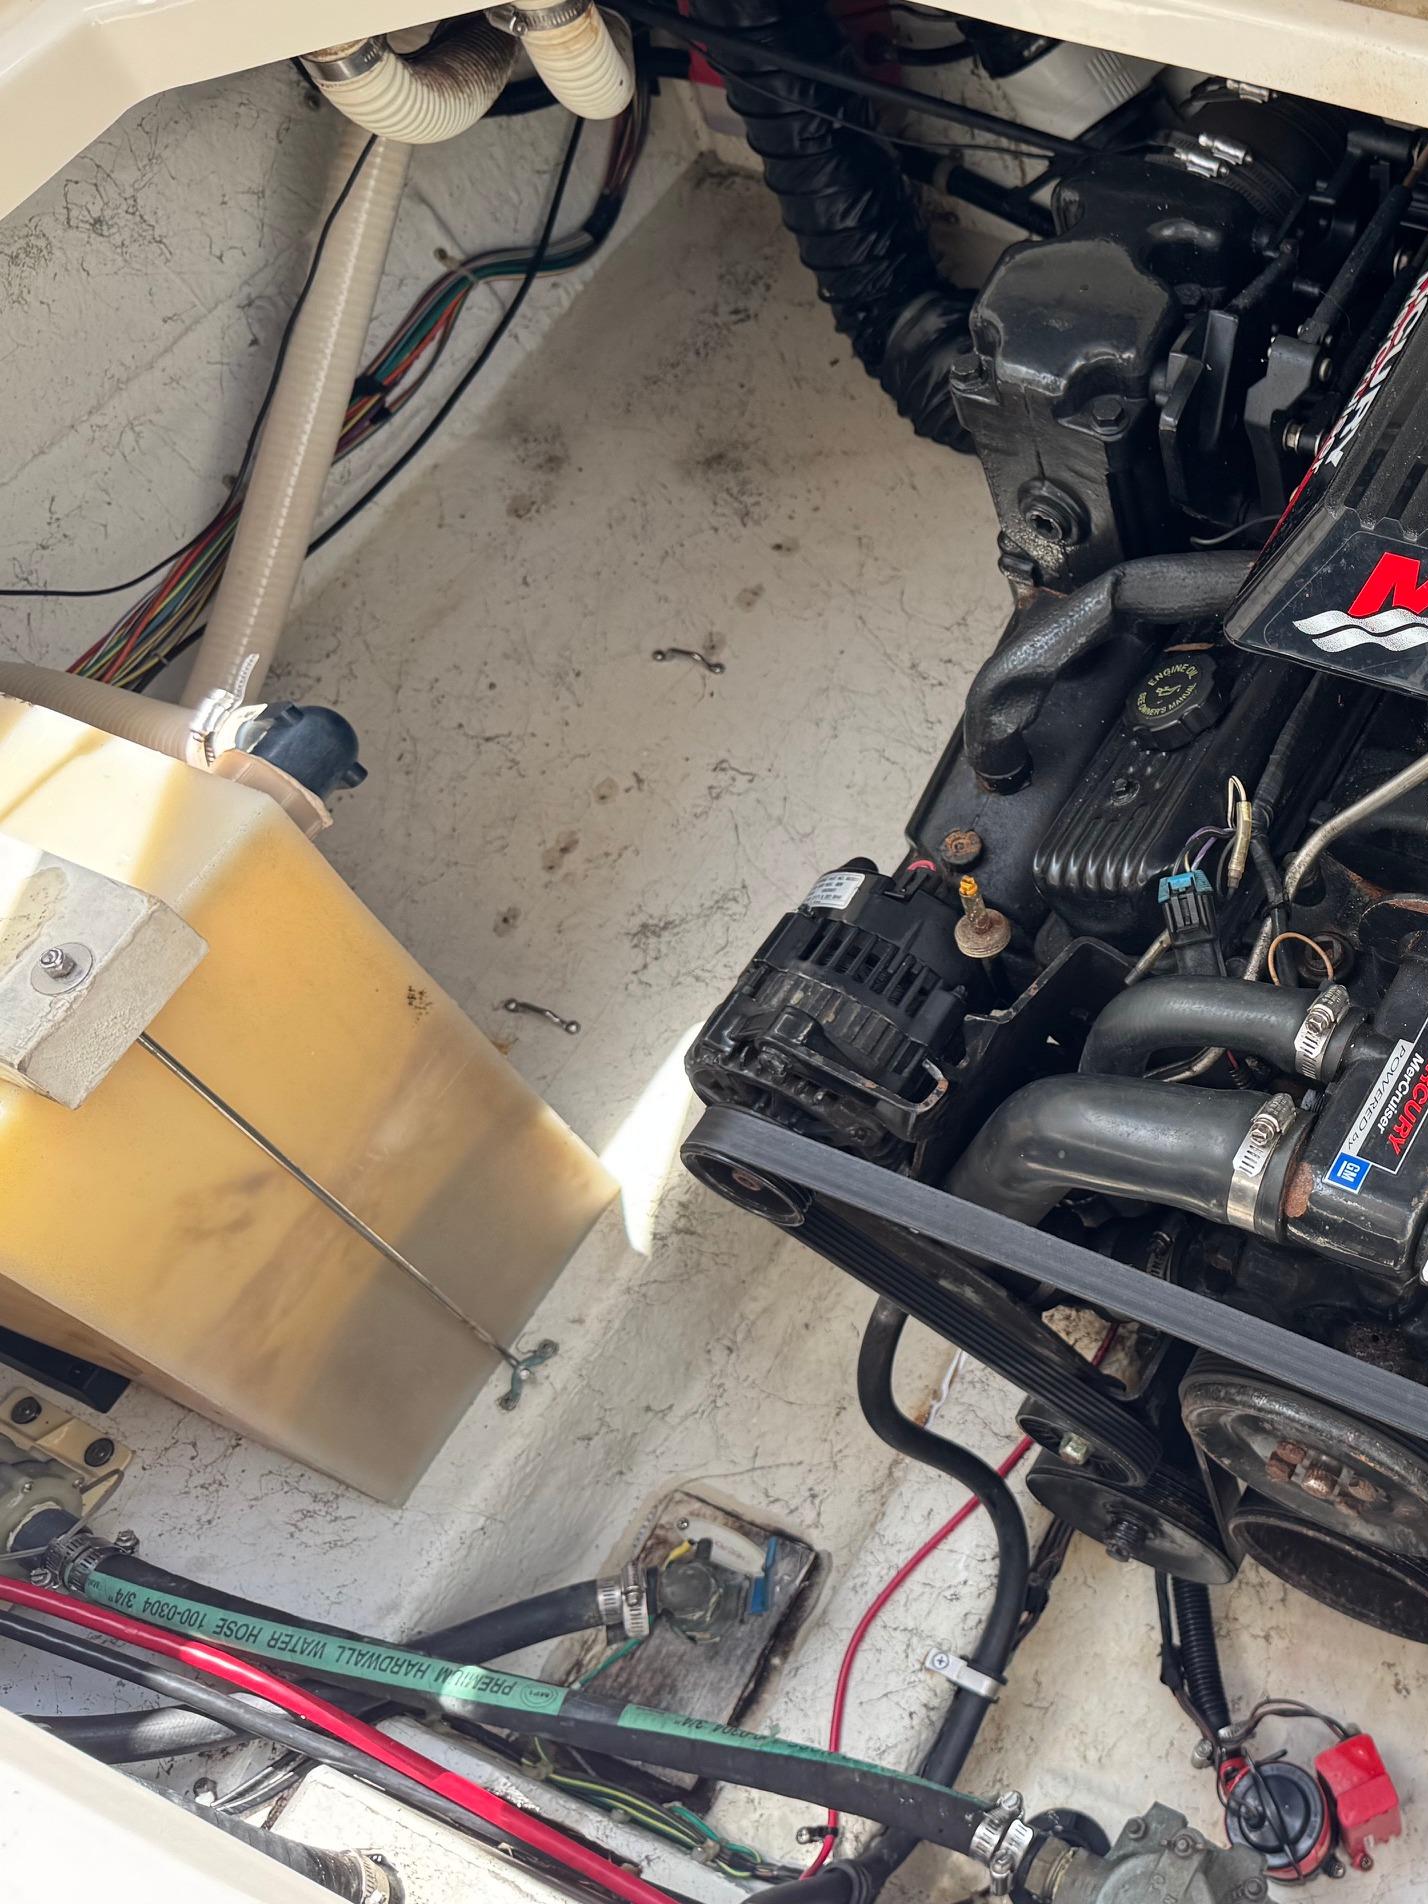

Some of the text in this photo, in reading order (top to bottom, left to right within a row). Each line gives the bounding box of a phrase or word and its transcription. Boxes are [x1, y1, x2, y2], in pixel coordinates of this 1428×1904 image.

[1148, 664, 1189, 686] ENGINE
[1168, 682, 1197, 710] MANUAL
[1359, 1045, 1406, 1132] POWERED
[1378, 1053, 1424, 1135] MerCruiser
[1342, 1161, 1361, 1183] GM
[108, 1587, 518, 1696] PREMIUM HARDWALL WATER HOSE 100-0304 3/4"
